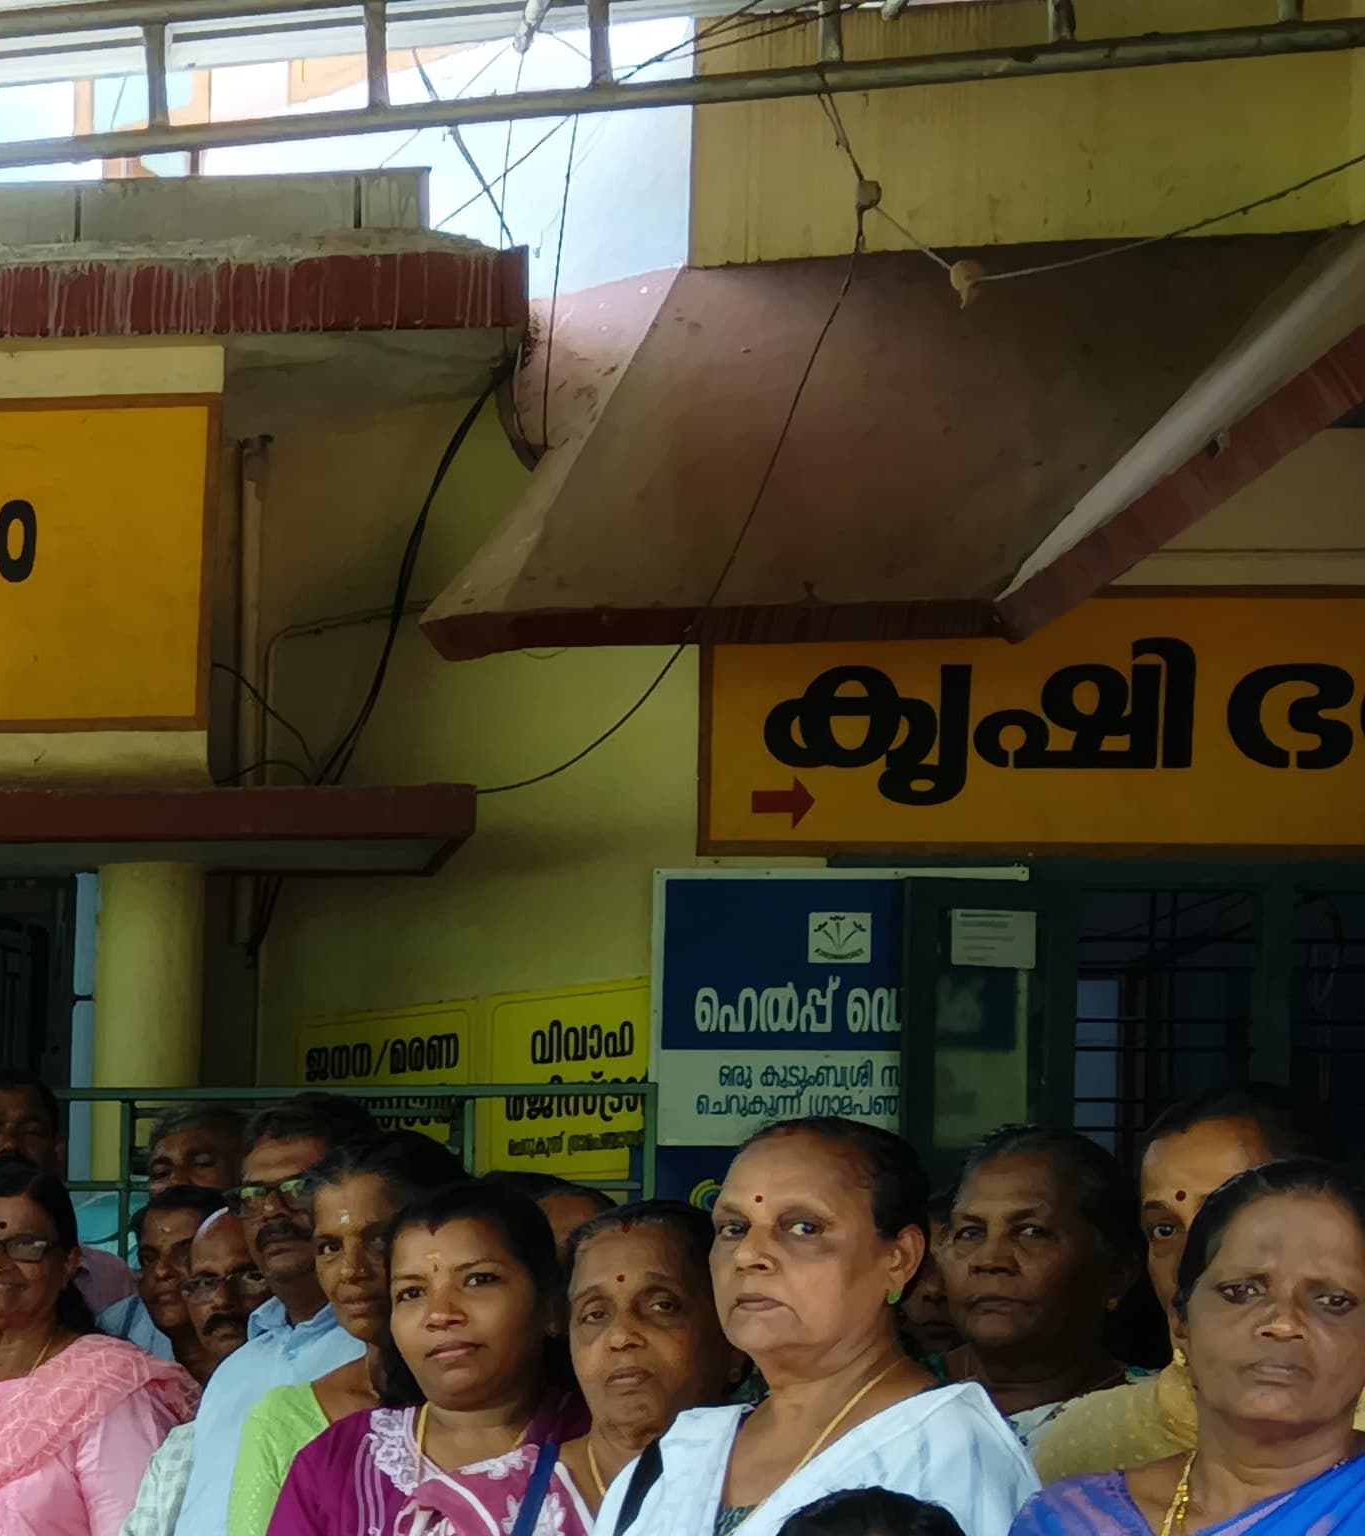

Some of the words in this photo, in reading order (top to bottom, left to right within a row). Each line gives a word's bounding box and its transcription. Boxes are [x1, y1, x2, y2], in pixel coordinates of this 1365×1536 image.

[763, 637, 1197, 806] കൃഷി
[1226, 662, 1365, 770] ഭ
[531, 1020, 634, 1065] വിവാഹ
[719, 1065, 753, 1089] ഒരു
